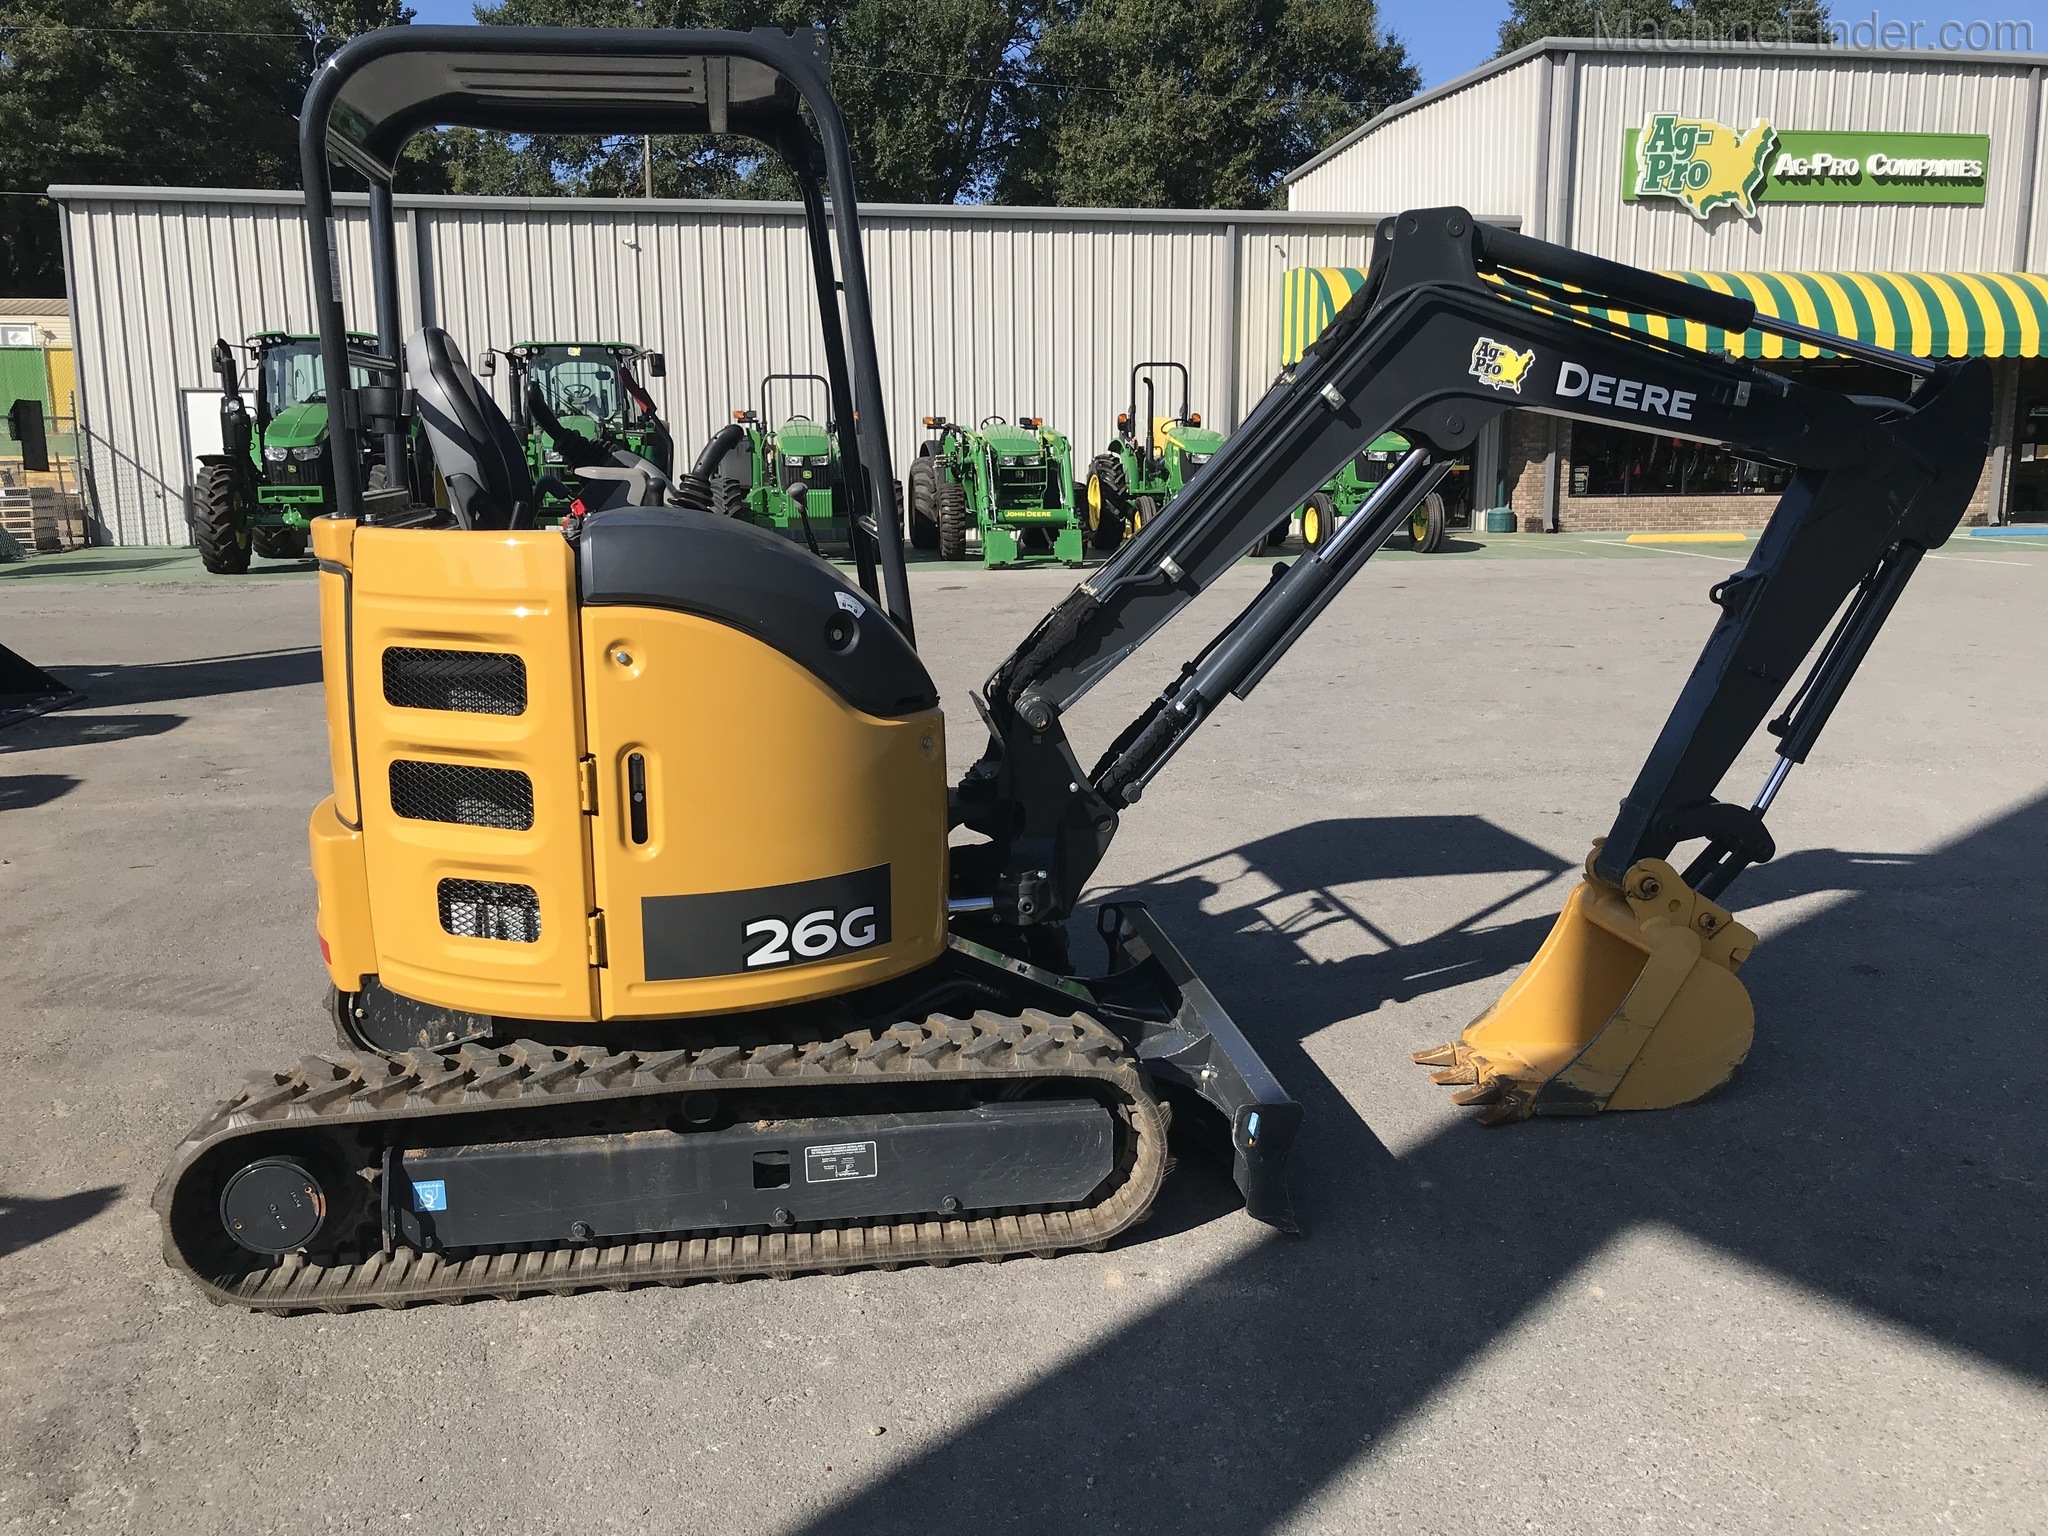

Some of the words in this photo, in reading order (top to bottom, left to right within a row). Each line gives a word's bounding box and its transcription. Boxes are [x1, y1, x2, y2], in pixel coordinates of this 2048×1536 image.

[1645, 114, 1713, 160] Ag-
[1642, 152, 1712, 191] Pro
[1866, 153, 1983, 177] COMPANIES
[1473, 356, 1502, 375] Pro
[1476, 341, 1505, 361] Ag-
[1556, 360, 1697, 421] DEERE
[746, 906, 876, 967] 26G
